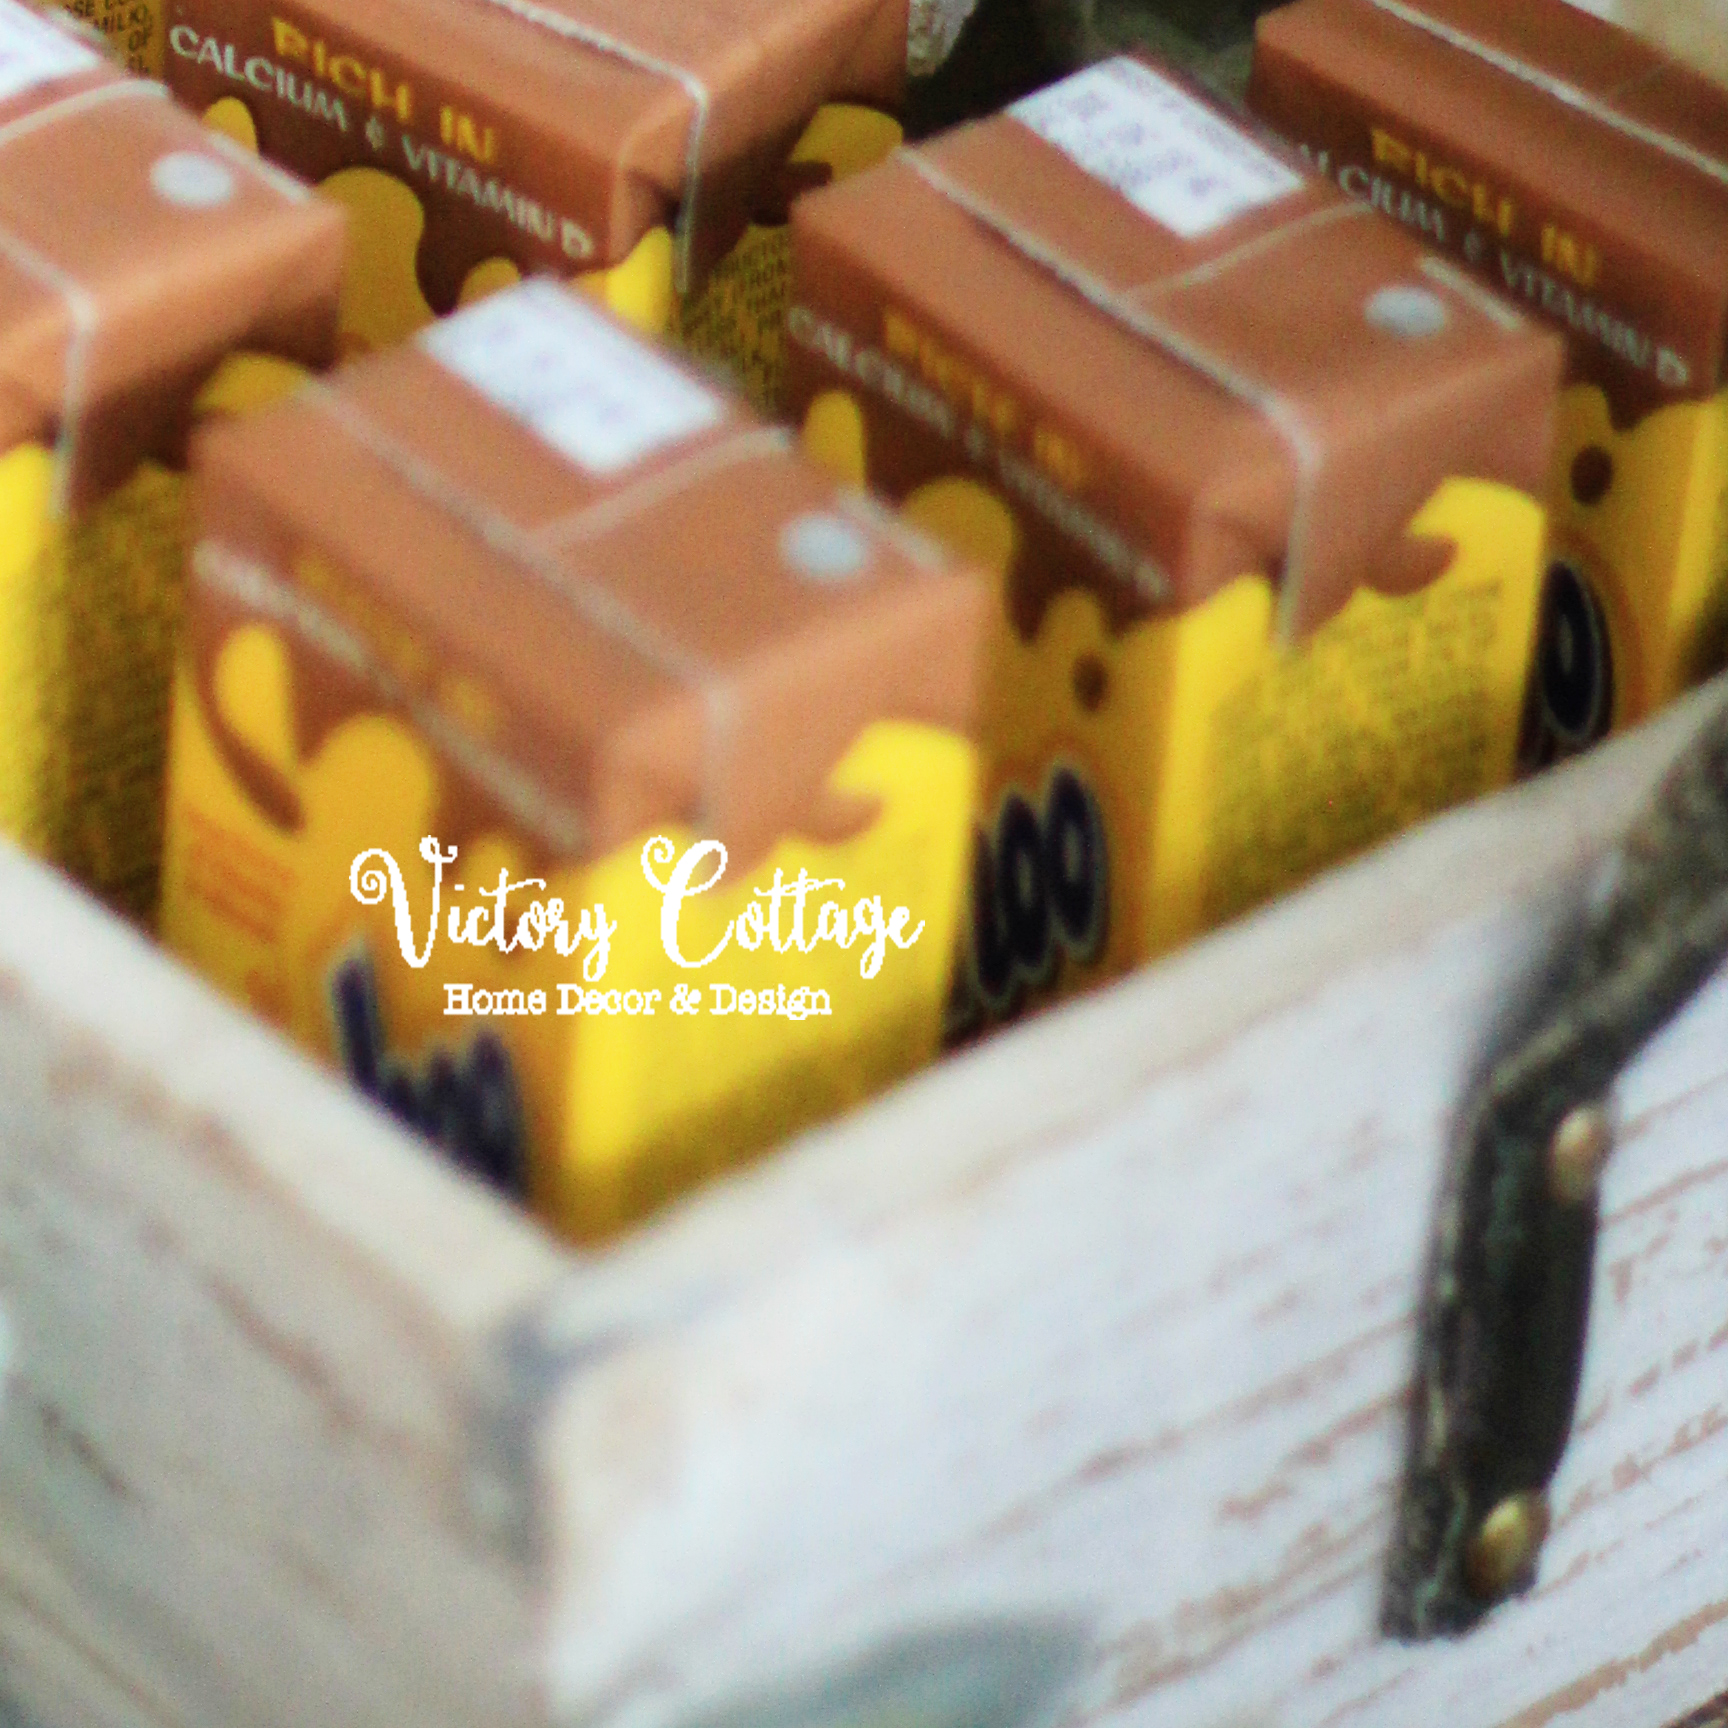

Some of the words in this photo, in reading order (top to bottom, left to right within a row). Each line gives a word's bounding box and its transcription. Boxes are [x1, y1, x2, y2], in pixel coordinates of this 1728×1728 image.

[169, 24, 349, 133] CALCIUM
[401, 134, 556, 242] VITAMIN
[560, 216, 593, 259] D
[272, 16, 413, 124] RICH
[439, 104, 495, 165] IN
[1373, 127, 1516, 238] RICH
